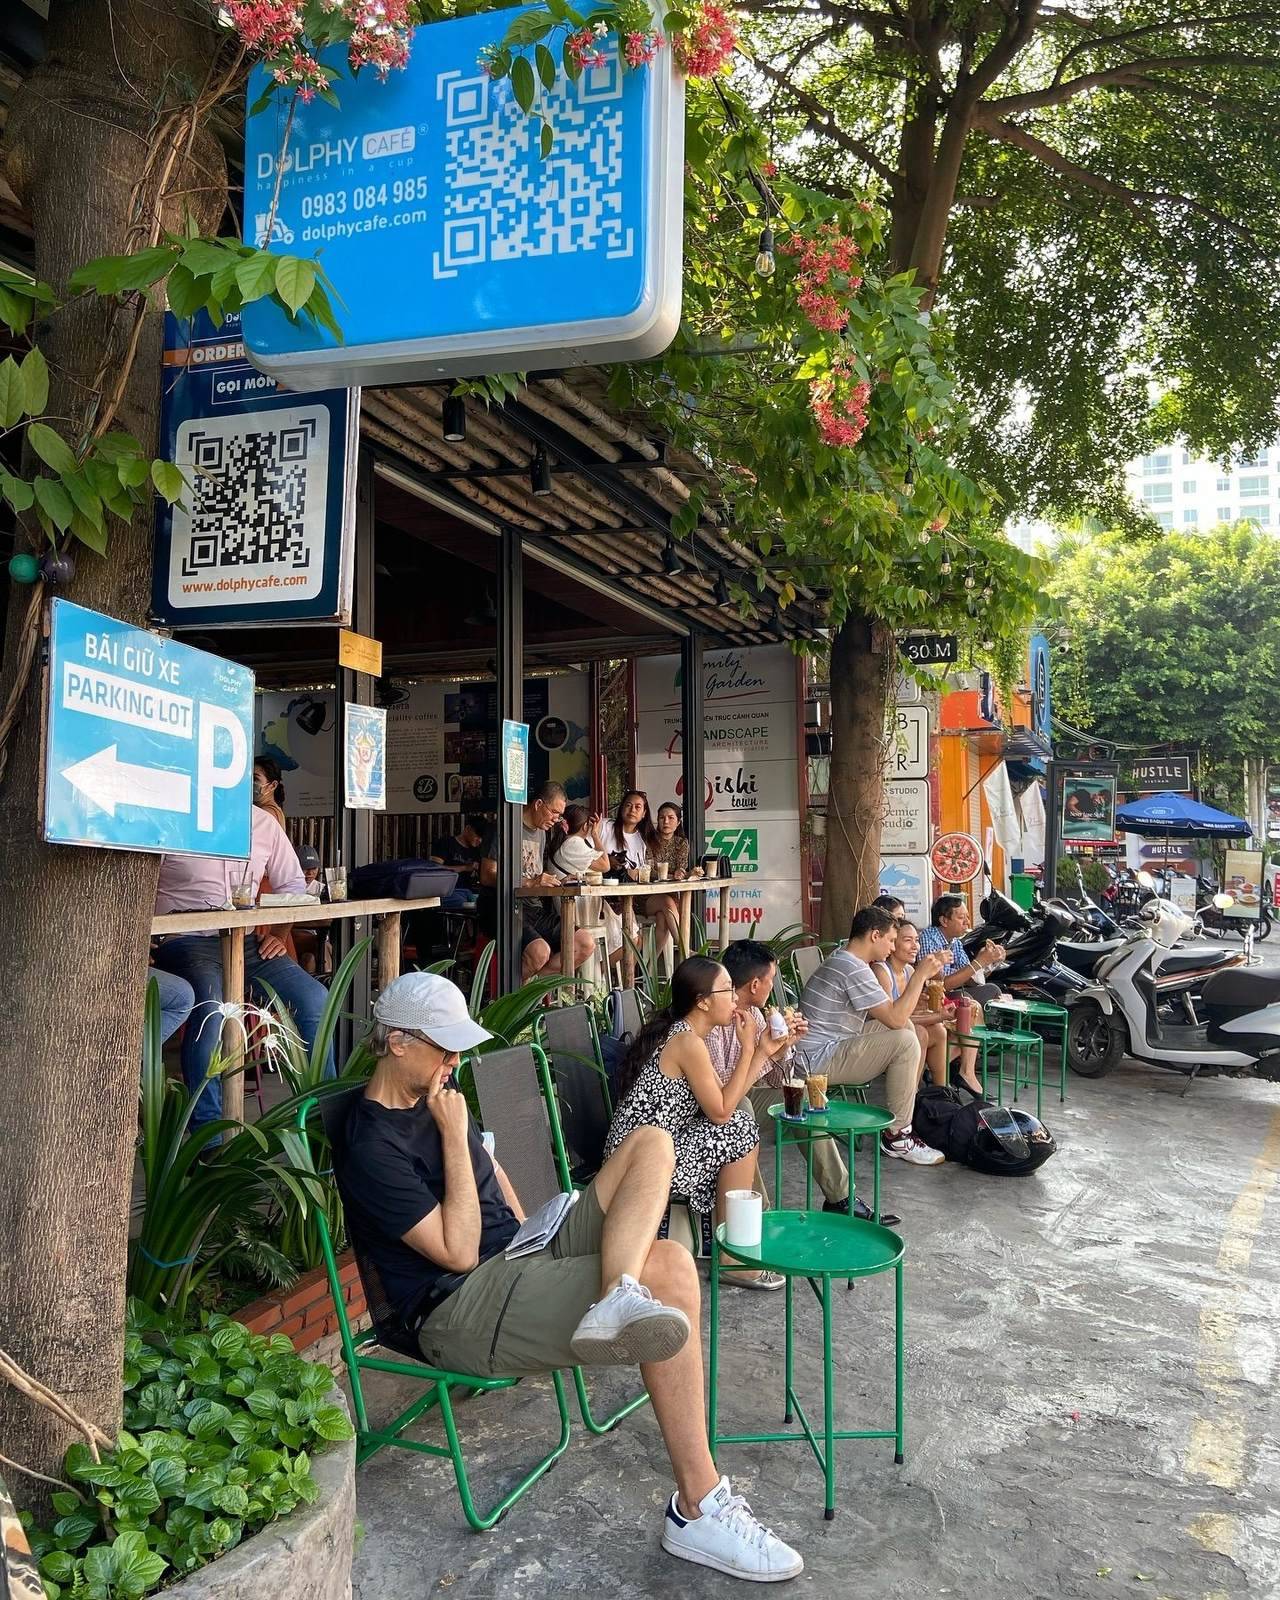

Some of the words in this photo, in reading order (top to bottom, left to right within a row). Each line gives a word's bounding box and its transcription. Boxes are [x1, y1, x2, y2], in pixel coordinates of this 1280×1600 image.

[366, 128, 412, 155] CAFÉ
[257, 172, 328, 191] hapiness
[342, 167, 354, 177] in
[389, 157, 414, 169] cup
[302, 190, 347, 220] 0983
[353, 183, 387, 211] 084
[393, 175, 428, 204] 985
[302, 209, 427, 242] dolphycafe.com
[192, 343, 246, 362] ORDER
[216, 379, 240, 395] GỌI
[182, 574, 308, 593] www.dolphycafe.com
[85, 632, 118, 666] BÃI
[158, 657, 180, 685] XE
[909, 644, 930, 659] 30
[936, 643, 950, 657] M
[705, 671, 765, 697] Garden
[68, 673, 153, 719] PARKING
[159, 700, 190, 727] LOT
[703, 726, 769, 741] ANDSCAPE
[196, 700, 248, 833] P
[1132, 766, 1182, 779] HUSTLE
[731, 794, 759, 808] town
[1151, 846, 1182, 855] HUSTLE
[731, 864, 754, 872] NTER
[703, 1214, 712, 1245] ICHY
